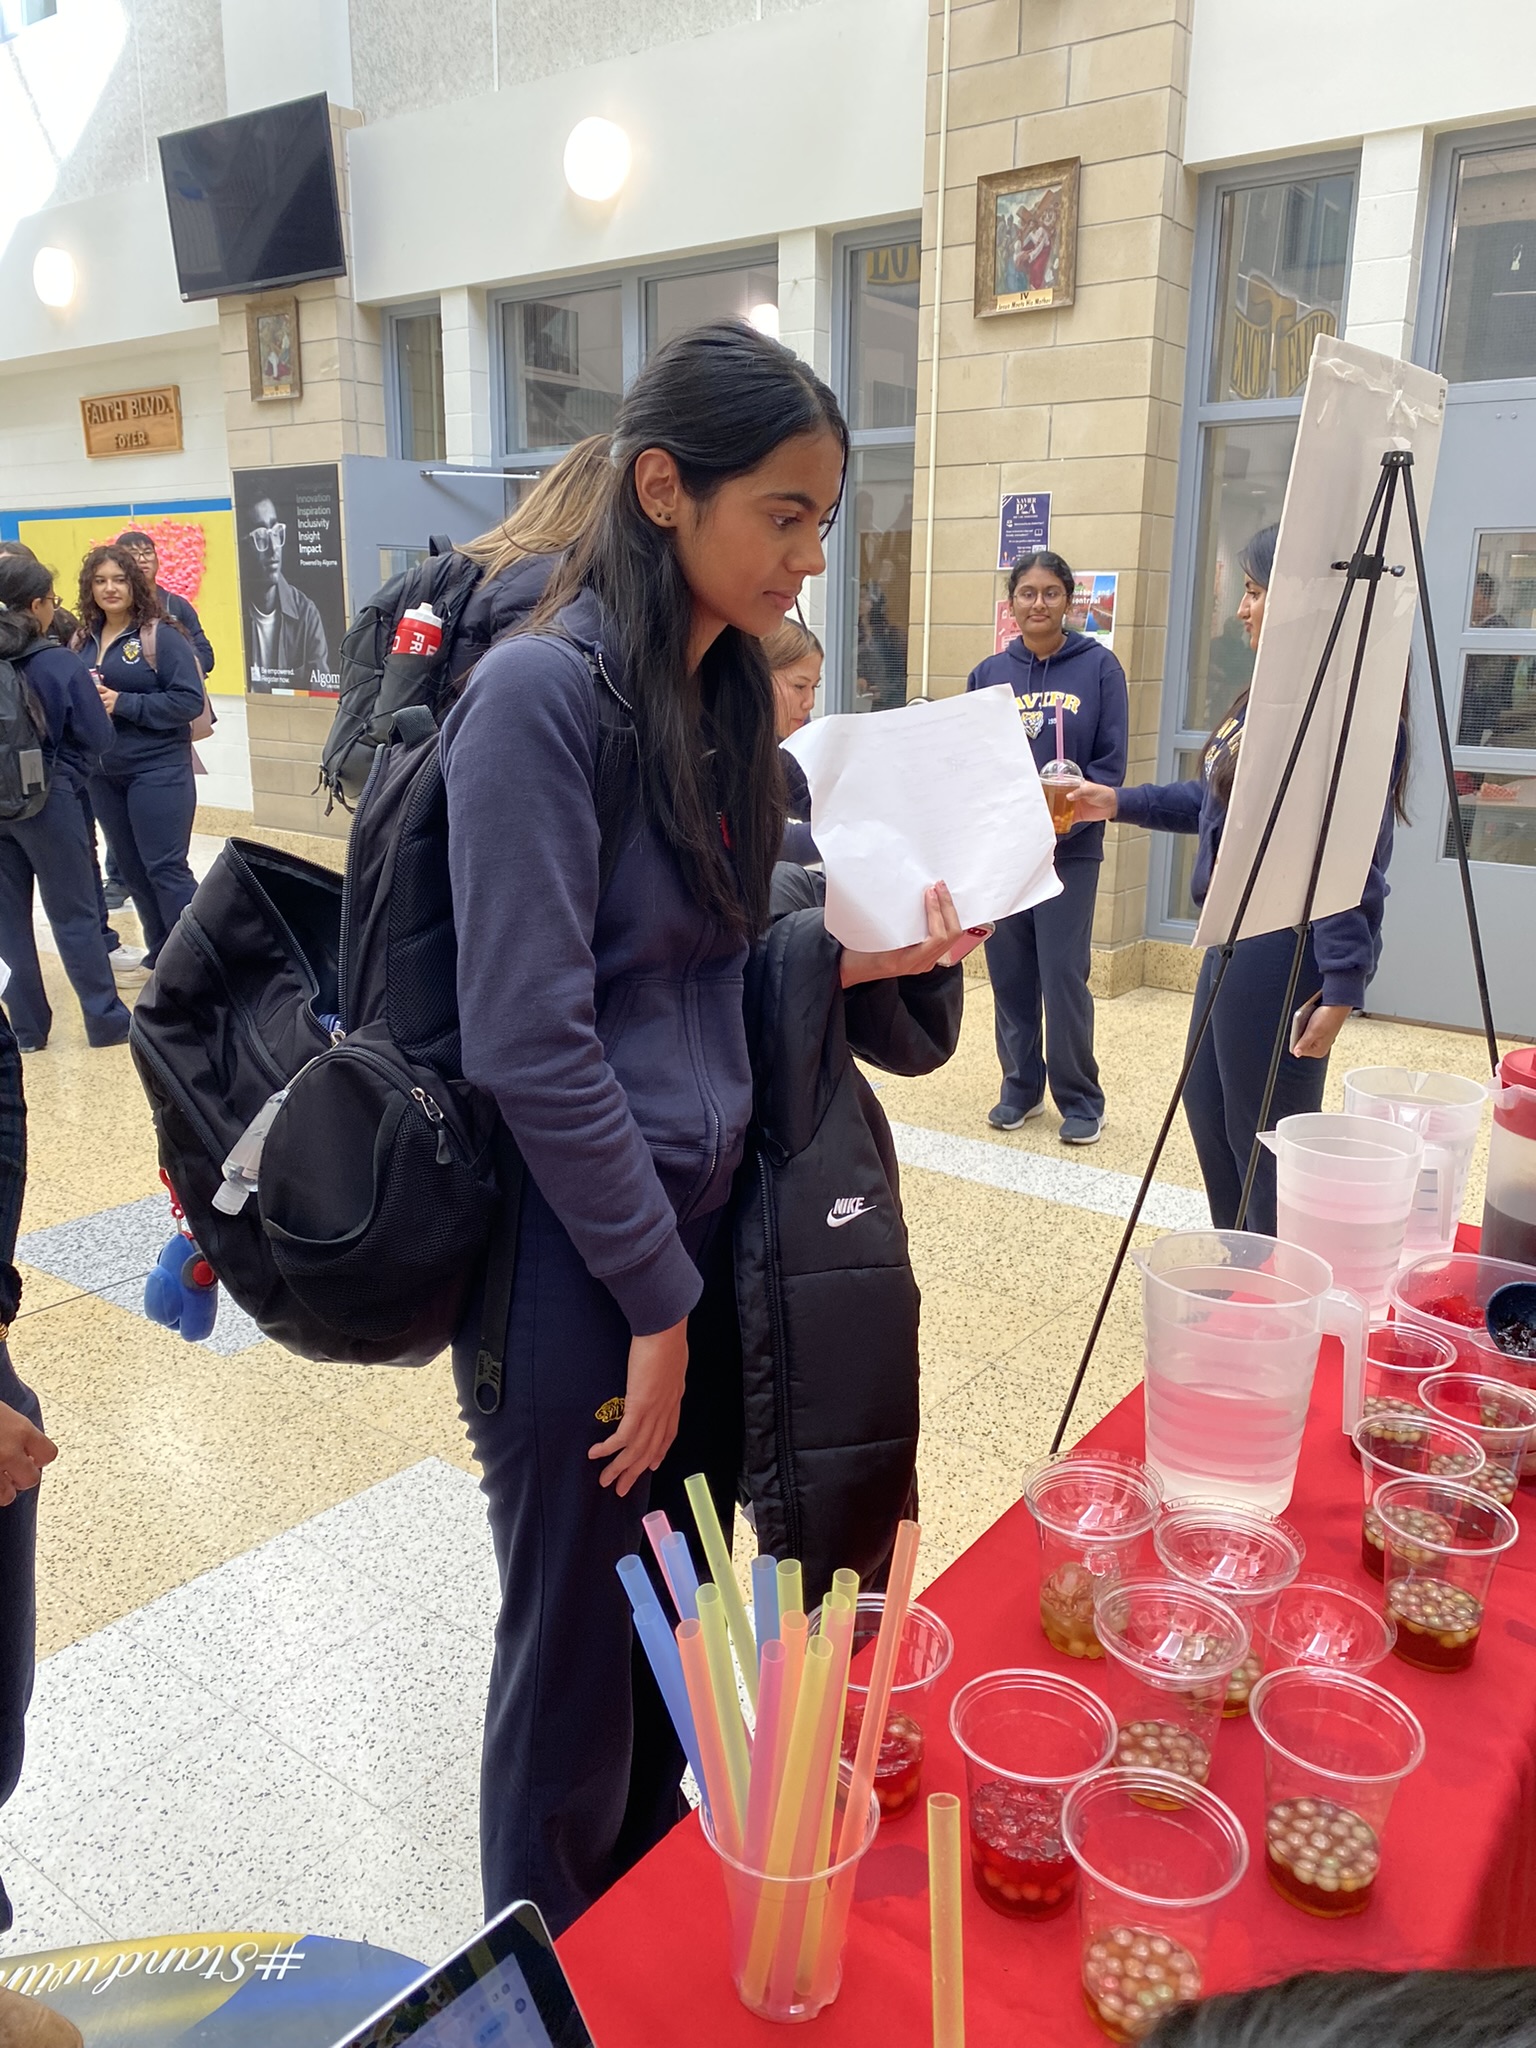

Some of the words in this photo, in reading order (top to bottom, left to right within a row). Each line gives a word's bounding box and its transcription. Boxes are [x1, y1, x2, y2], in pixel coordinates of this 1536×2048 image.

[1020, 292, 1029, 300] IV
[85, 401, 125, 424] FAITH
[131, 395, 172, 418] BLVD.
[115, 431, 147, 449] FOYER
[296, 494, 331, 503] Innovation
[297, 506, 331, 517] Inspiration
[297, 519, 330, 530] Inclusivity
[298, 531, 320, 543] Insight
[299, 543, 322, 556] Impact
[310, 669, 340, 688] Algom
[833, 1196, 865, 1215] NIKE
